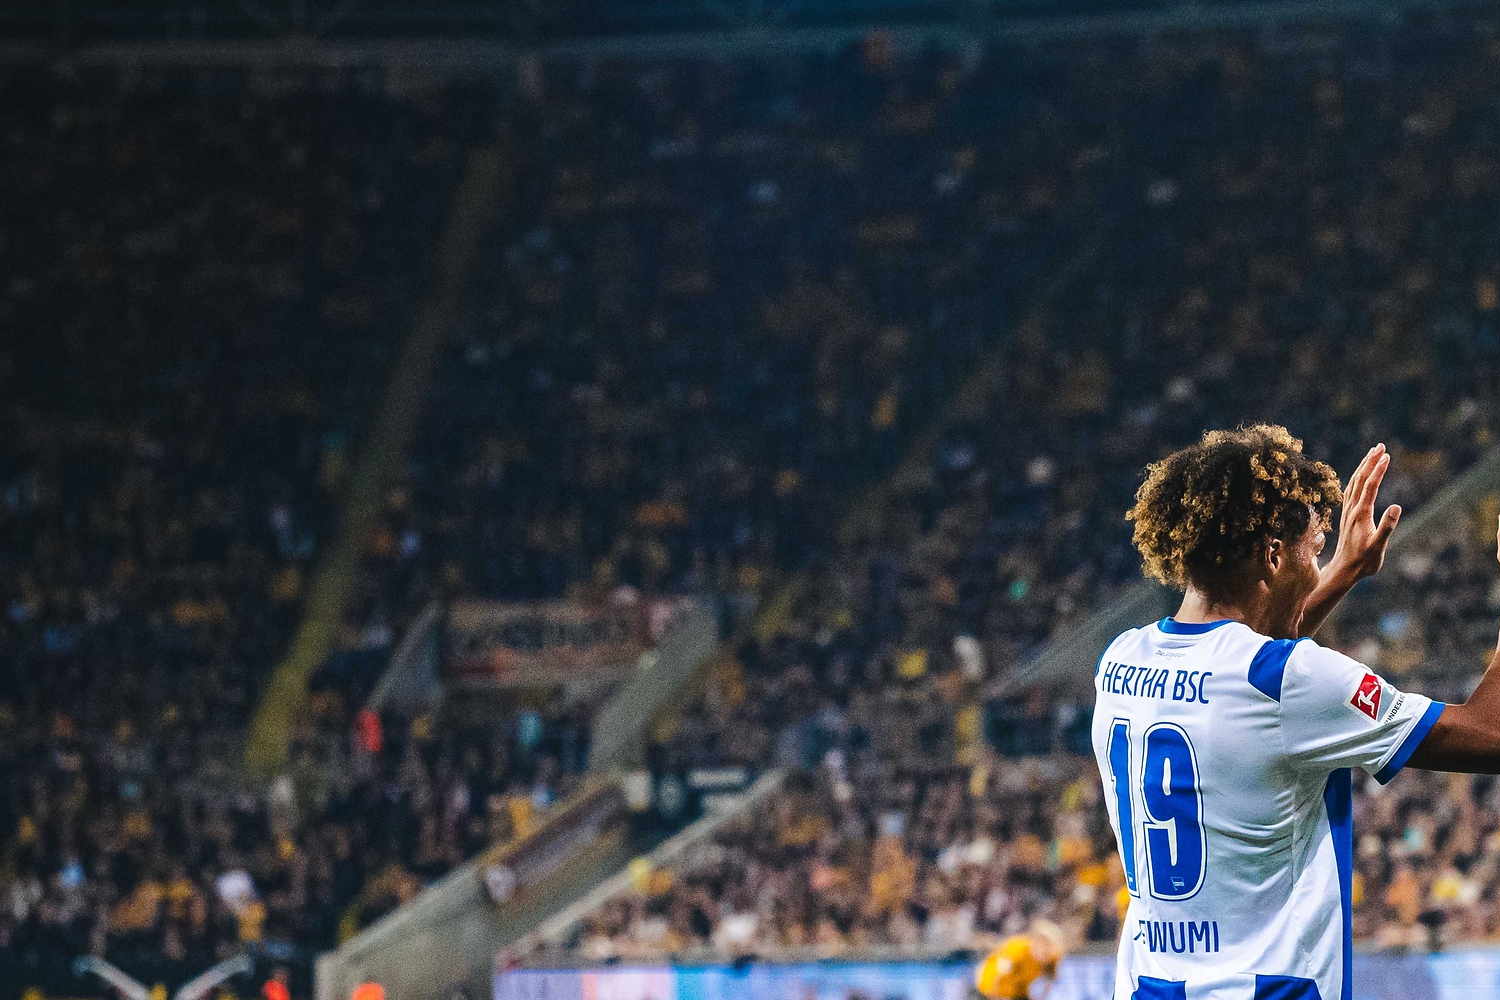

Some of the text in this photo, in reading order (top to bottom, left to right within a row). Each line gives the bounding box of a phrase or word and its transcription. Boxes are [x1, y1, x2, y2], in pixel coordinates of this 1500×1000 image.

[1102, 661, 1213, 704] HERTHA BSC
[1106, 717, 1208, 901] 19
[1134, 919, 1220, 953] WUMI
